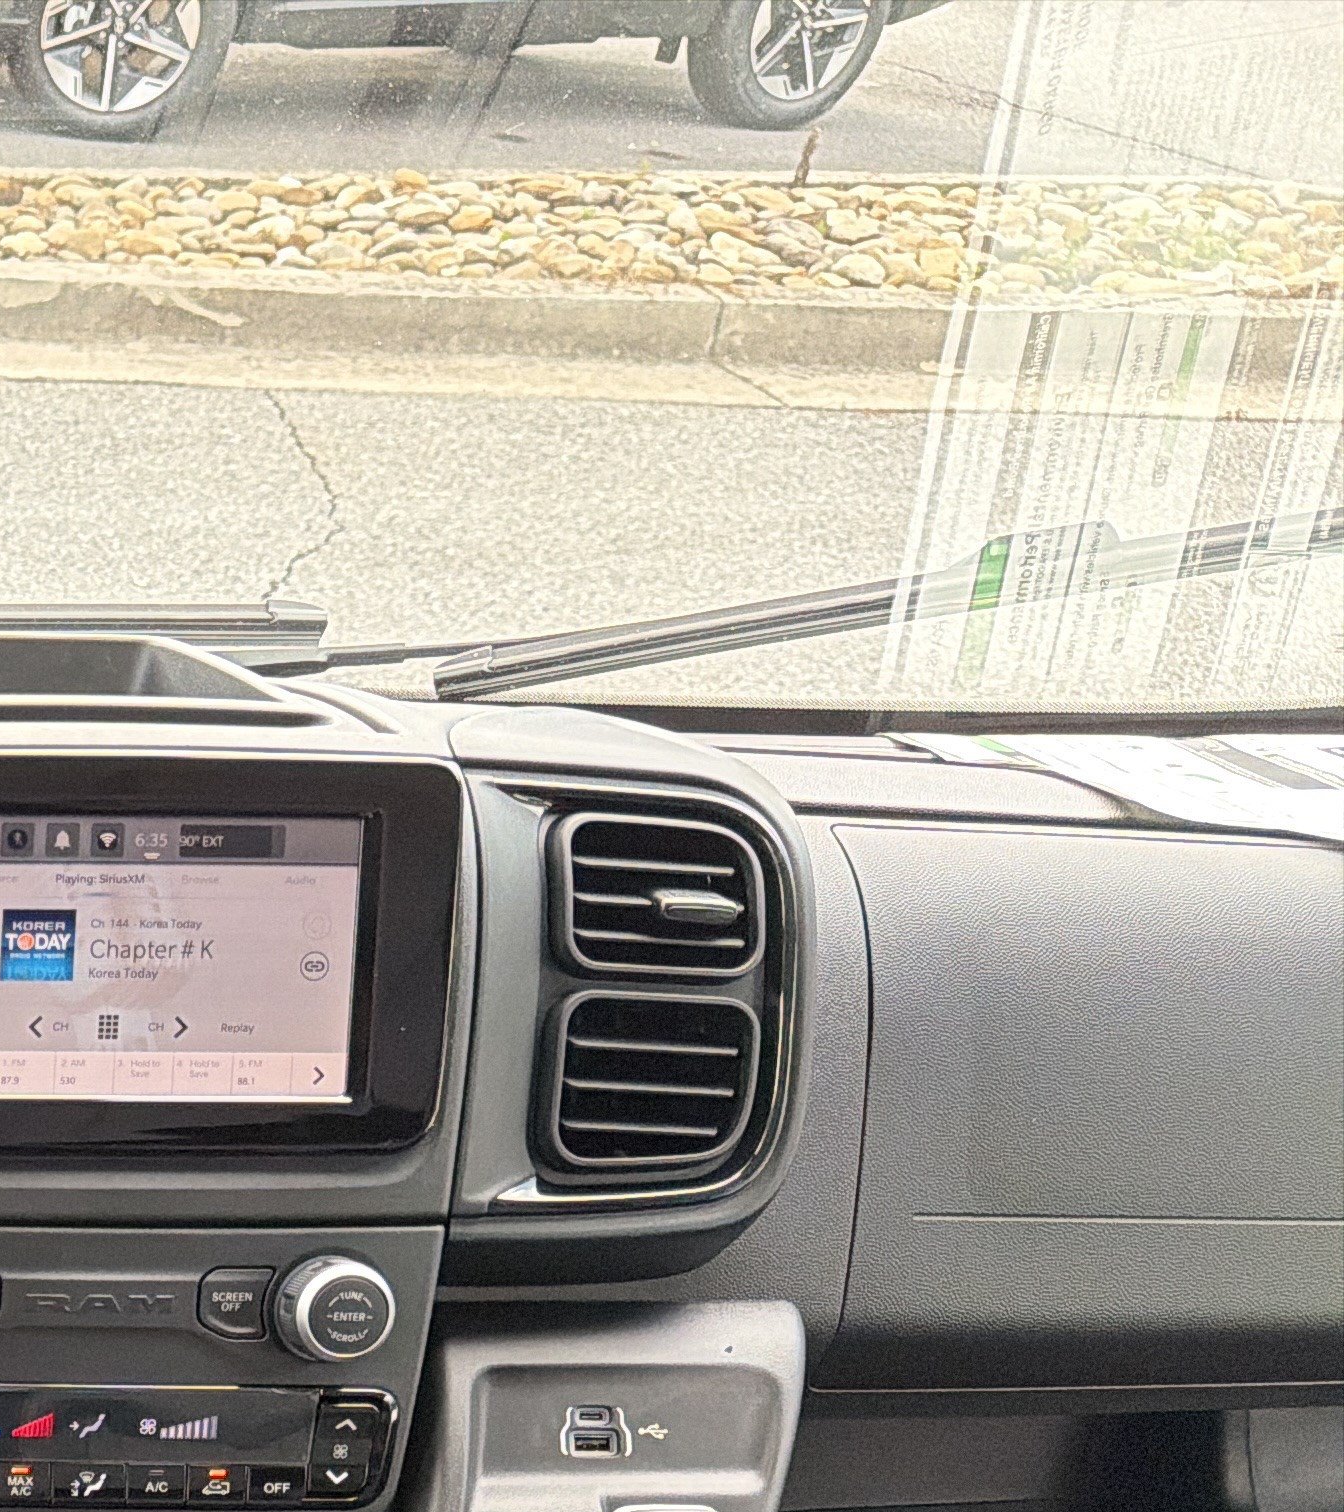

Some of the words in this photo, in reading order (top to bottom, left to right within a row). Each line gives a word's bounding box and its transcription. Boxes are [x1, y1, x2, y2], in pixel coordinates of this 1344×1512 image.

[202, 835, 223, 848] EXT
[55, 874, 96, 886] Playing:
[99, 874, 146, 885] SiriusXM
[90, 919, 104, 929] Ch
[112, 919, 129, 928] 144
[140, 919, 168, 929] Korea
[172, 919, 202, 930] Today
[5, 933, 71, 950] TODAY
[90, 939, 177, 962] Chapter
[181, 940, 195, 958] #
[201, 940, 214, 959] K
[88, 968, 120, 978] Korea
[124, 968, 158, 980] Today
[53, 1023, 68, 1032] CH
[148, 1023, 164, 1032] CH
[221, 1023, 254, 1036] Replay
[1, 1077, 19, 1085] 87.9
[212, 1292, 253, 1302] SCREEN
[339, 1292, 364, 1301] TUNE
[221, 1303, 241, 1312] OFF
[333, 1312, 365, 1322] ENTER
[331, 1331, 364, 1342] SCROLL
[7, 1477, 34, 1486] MAX
[10, 1487, 32, 1497] A/C
[145, 1482, 168, 1493] A/C
[264, 1482, 291, 1493] OFF
